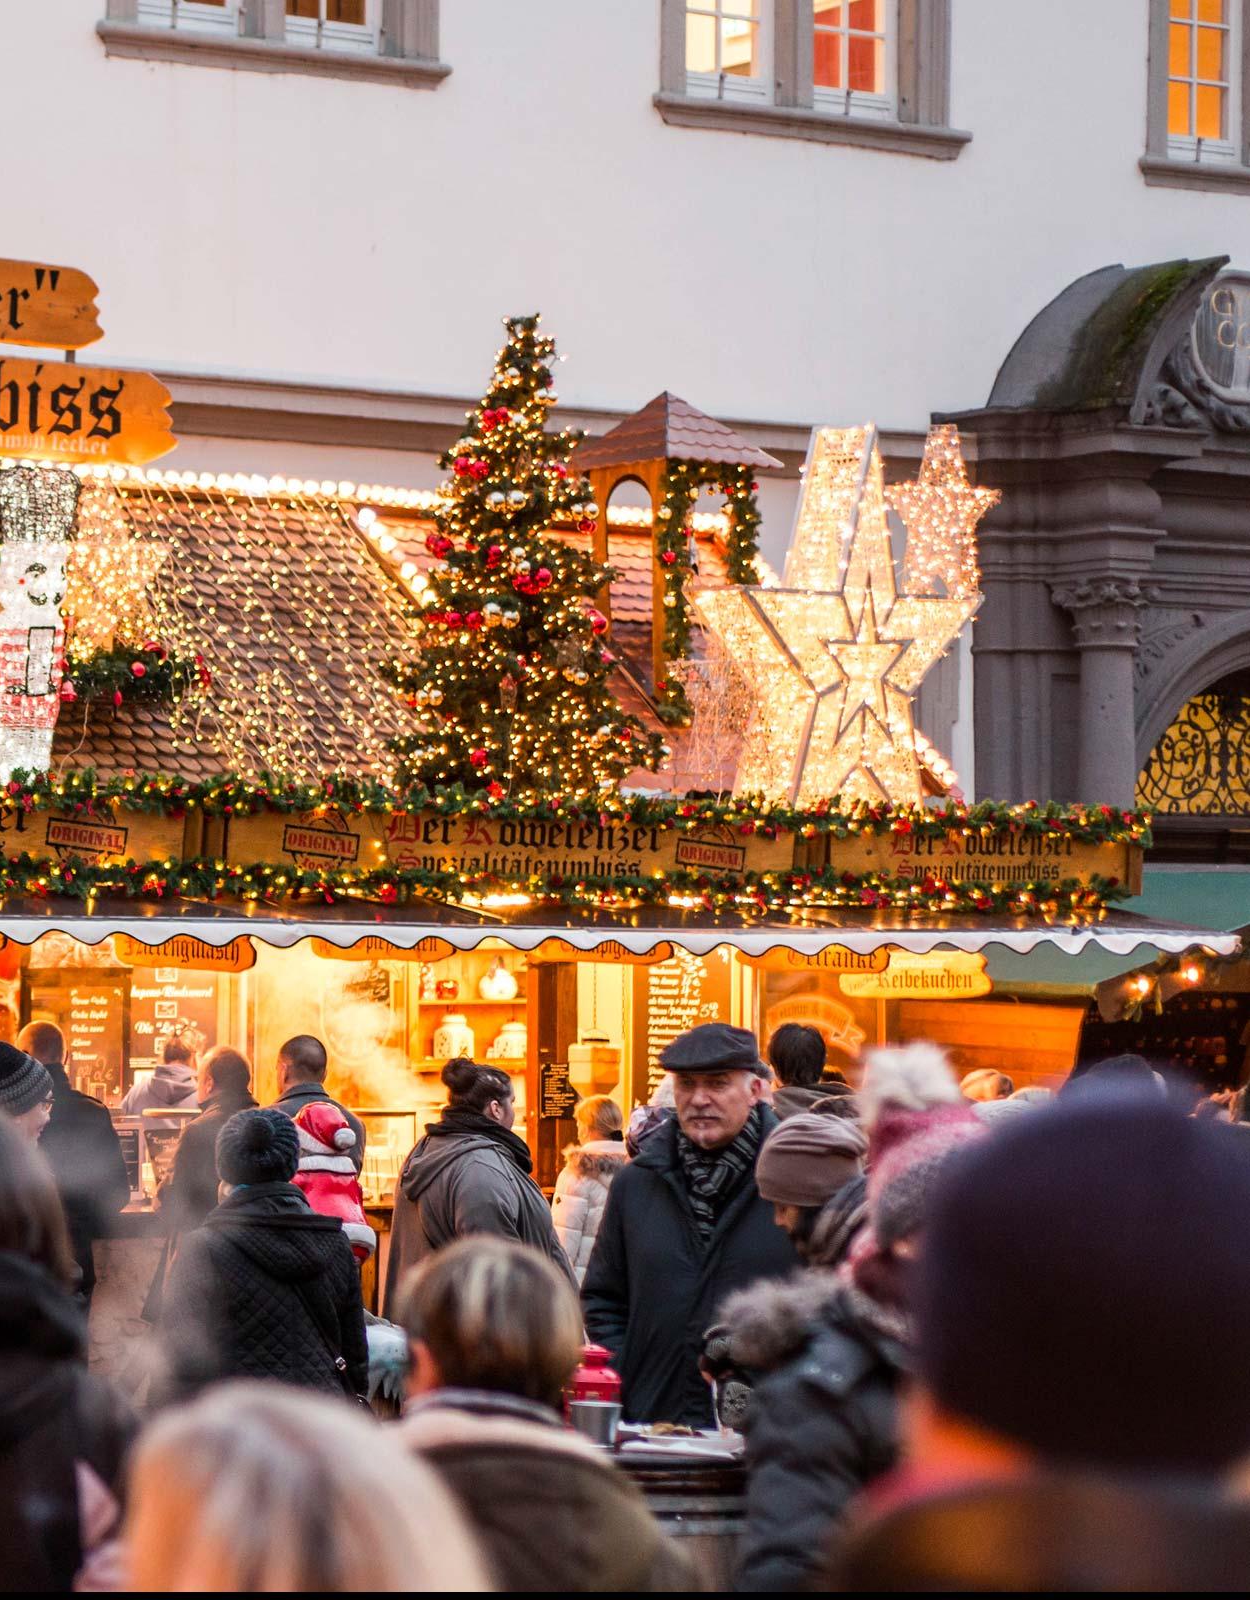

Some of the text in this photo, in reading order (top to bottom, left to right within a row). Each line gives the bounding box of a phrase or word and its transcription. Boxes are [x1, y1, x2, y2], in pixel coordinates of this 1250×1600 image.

[51, 825, 123, 849] ORIGINAL
[287, 832, 355, 855] ORIGINAL
[384, 815, 457, 845] Der
[461, 816, 662, 859] Kowelenzer
[680, 845, 740, 866] ORIGINAL
[878, 968, 973, 991] Reibekuchen
